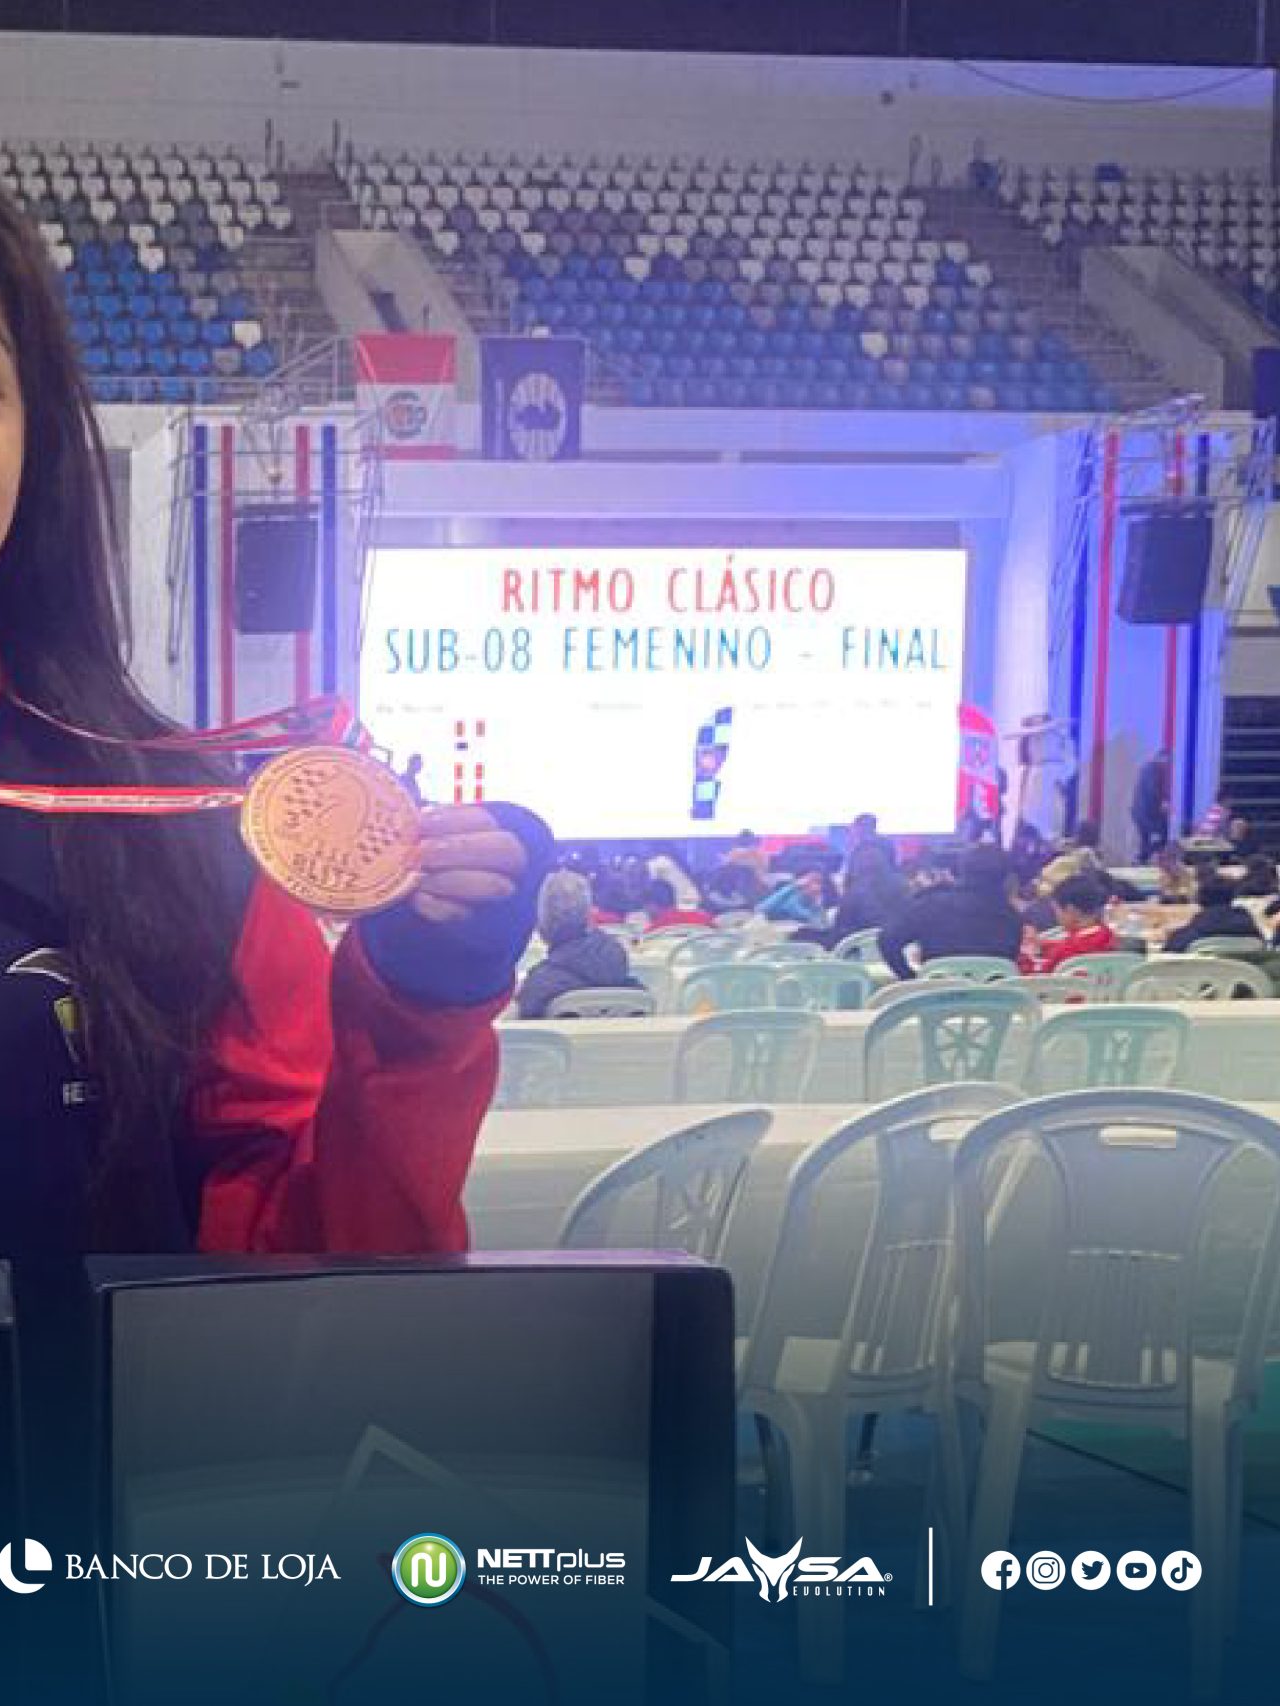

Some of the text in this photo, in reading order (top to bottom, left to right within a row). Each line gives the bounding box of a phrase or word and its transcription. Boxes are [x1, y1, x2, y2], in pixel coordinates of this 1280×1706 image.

[500, 553, 837, 614] RITMO CLÁSICO
[384, 627, 534, 674] SUB-08
[562, 626, 774, 673] FEMENINO
[841, 626, 948, 671] FINAL
